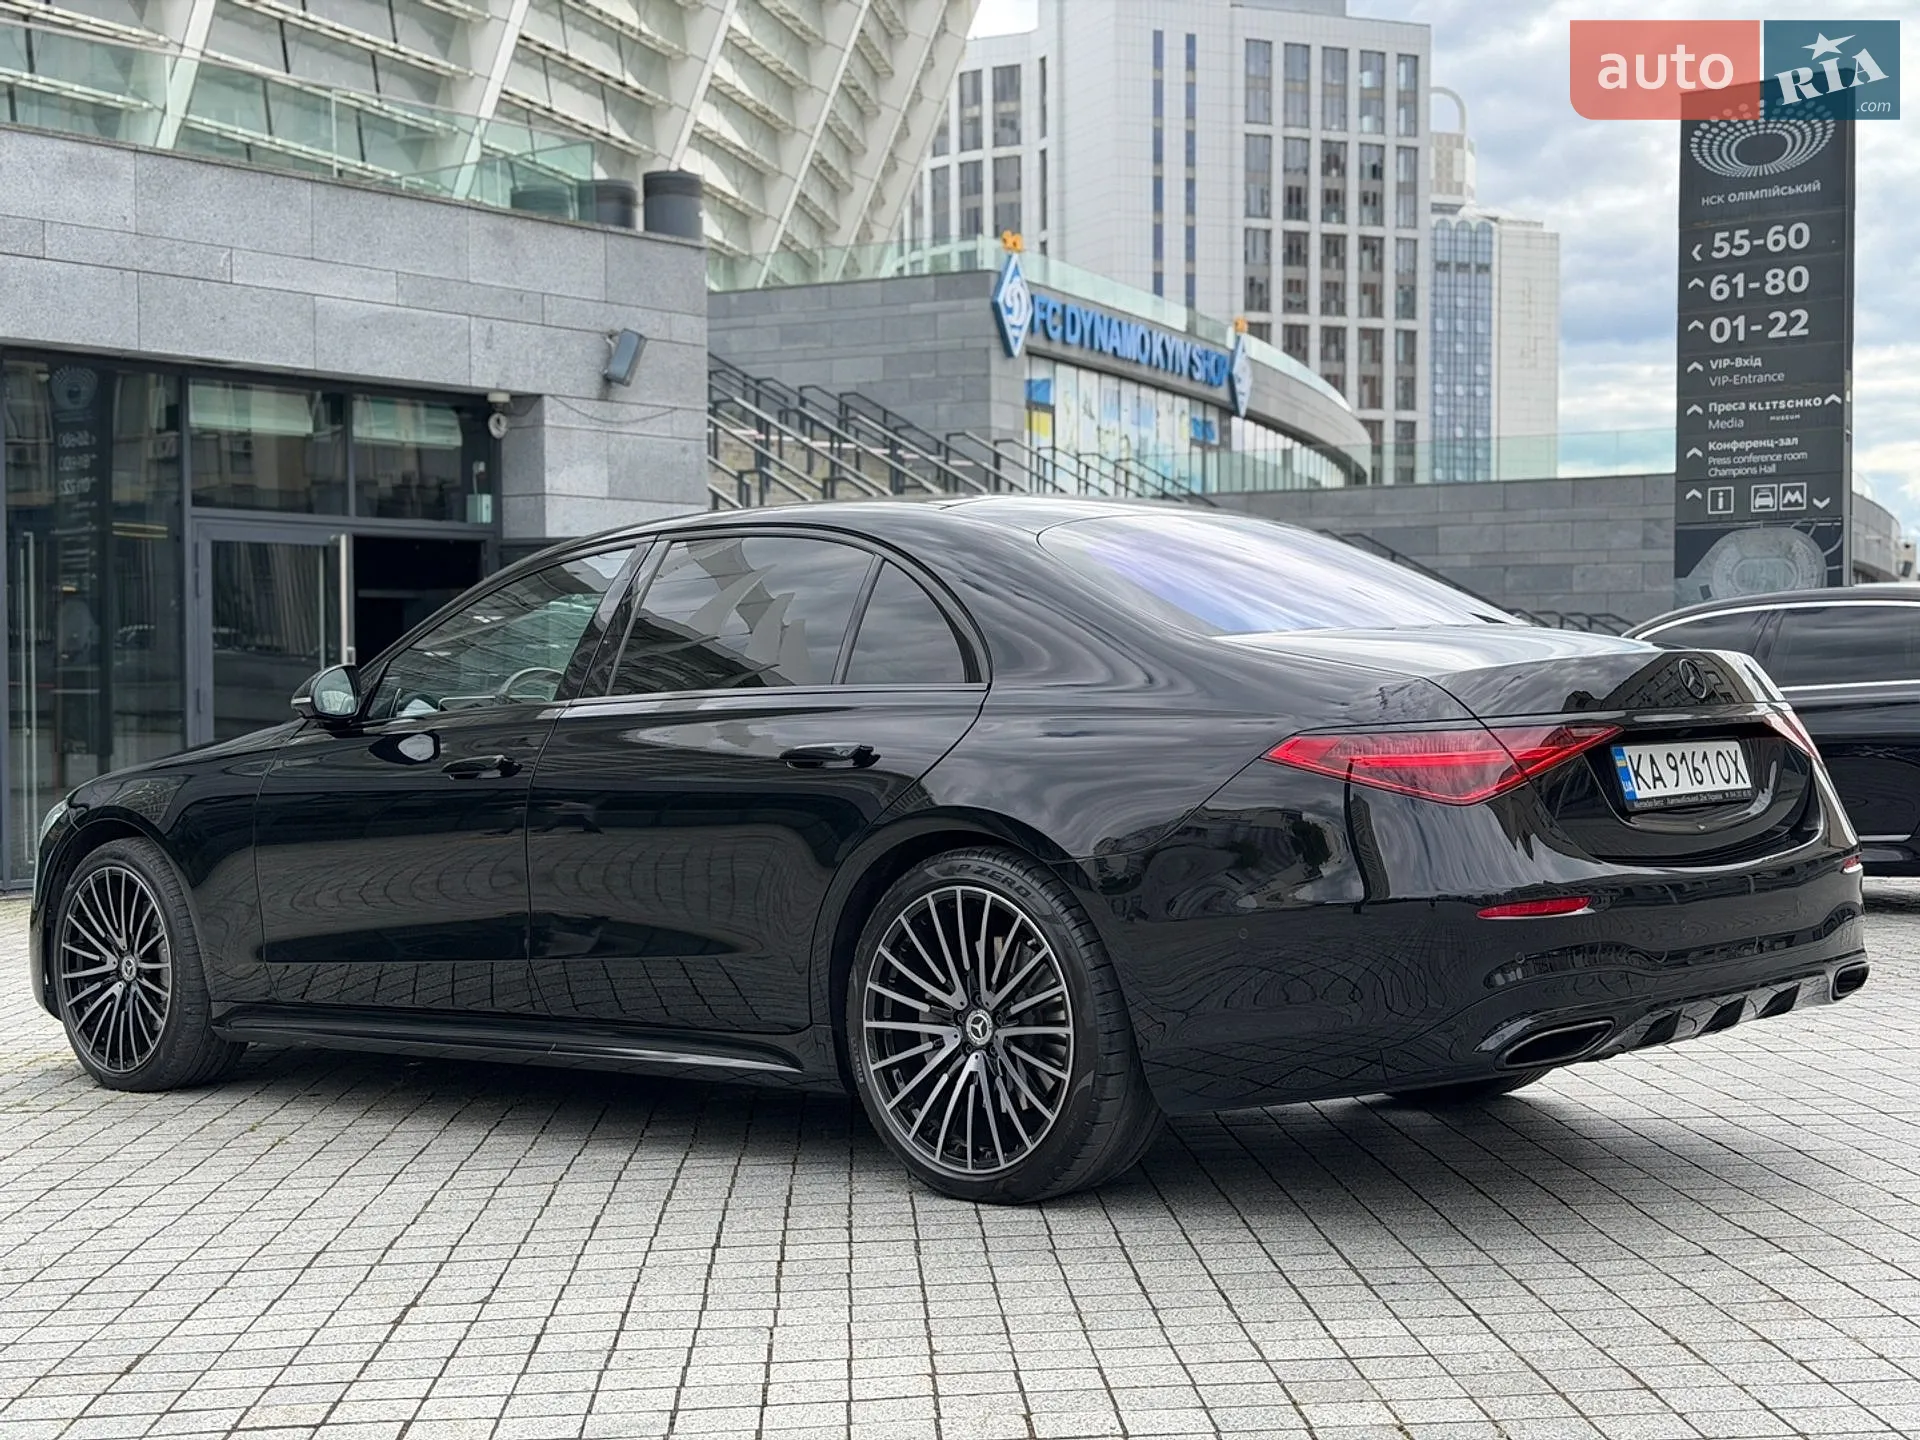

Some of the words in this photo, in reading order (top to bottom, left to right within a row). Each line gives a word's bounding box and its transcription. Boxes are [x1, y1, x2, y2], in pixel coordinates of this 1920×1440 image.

[1701, 192, 1725, 207] НСК
[1728, 180, 1822, 203] ОЛІМПІЙСЬКИЙ
[1711, 222, 1811, 259] 55-60
[1709, 265, 1810, 302] 61-80
[1709, 308, 1810, 344] 01-22
[1033, 295, 1063, 340] FC
[1065, 304, 1151, 364] DYNAMO
[1191, 344, 1229, 388] SHOP
[1709, 355, 1763, 371] VIP-Вхід
[1709, 371, 1785, 387] VIP-Entrance
[1708, 402, 1746, 415] Преса
[1749, 396, 1823, 411] KLITSCHKO
[1708, 417, 1744, 430] Media
[1708, 437, 1799, 452] Конференц-зал
[1708, 455, 1732, 465] Press
[1733, 452, 1783, 465] conference
[1784, 451, 1808, 461] room
[1708, 465, 1758, 478] Champions
[1759, 464, 1776, 474] Hall
[1666, 750, 1715, 788] 9161
